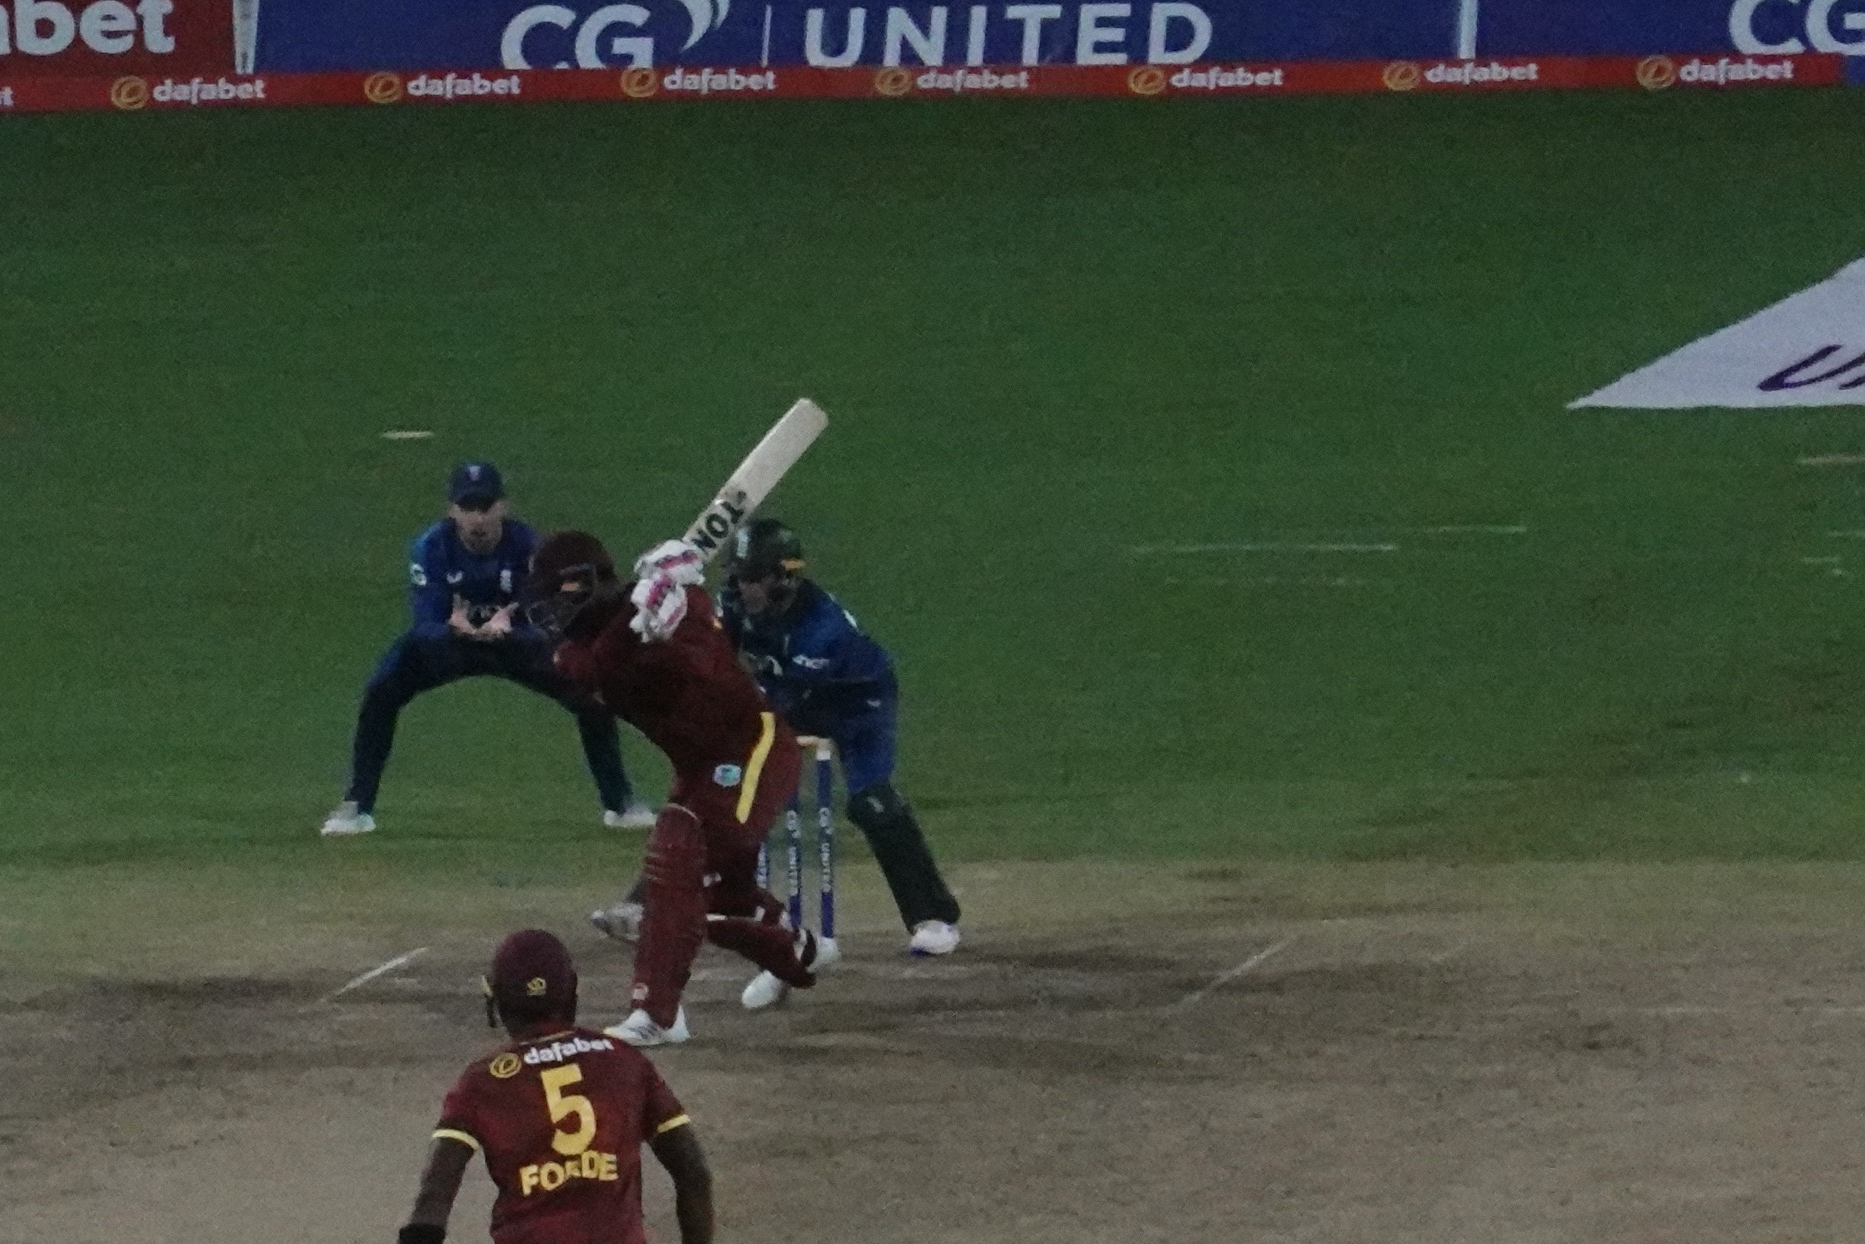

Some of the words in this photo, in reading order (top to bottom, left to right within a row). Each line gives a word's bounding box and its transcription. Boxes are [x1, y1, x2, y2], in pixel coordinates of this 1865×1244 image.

[501, 3, 654, 70] CG
[804, 2, 1213, 67] UNITED
[663, 68, 775, 94] dafabet
[917, 69, 1028, 92] dafabet
[1167, 63, 1282, 89] dafabet
[1424, 57, 1538, 84] dafabet
[1680, 58, 1793, 84] dafabet
[153, 78, 265, 104] dafabet
[407, 73, 520, 98] dafabet
[540, 1063, 598, 1156] 5
